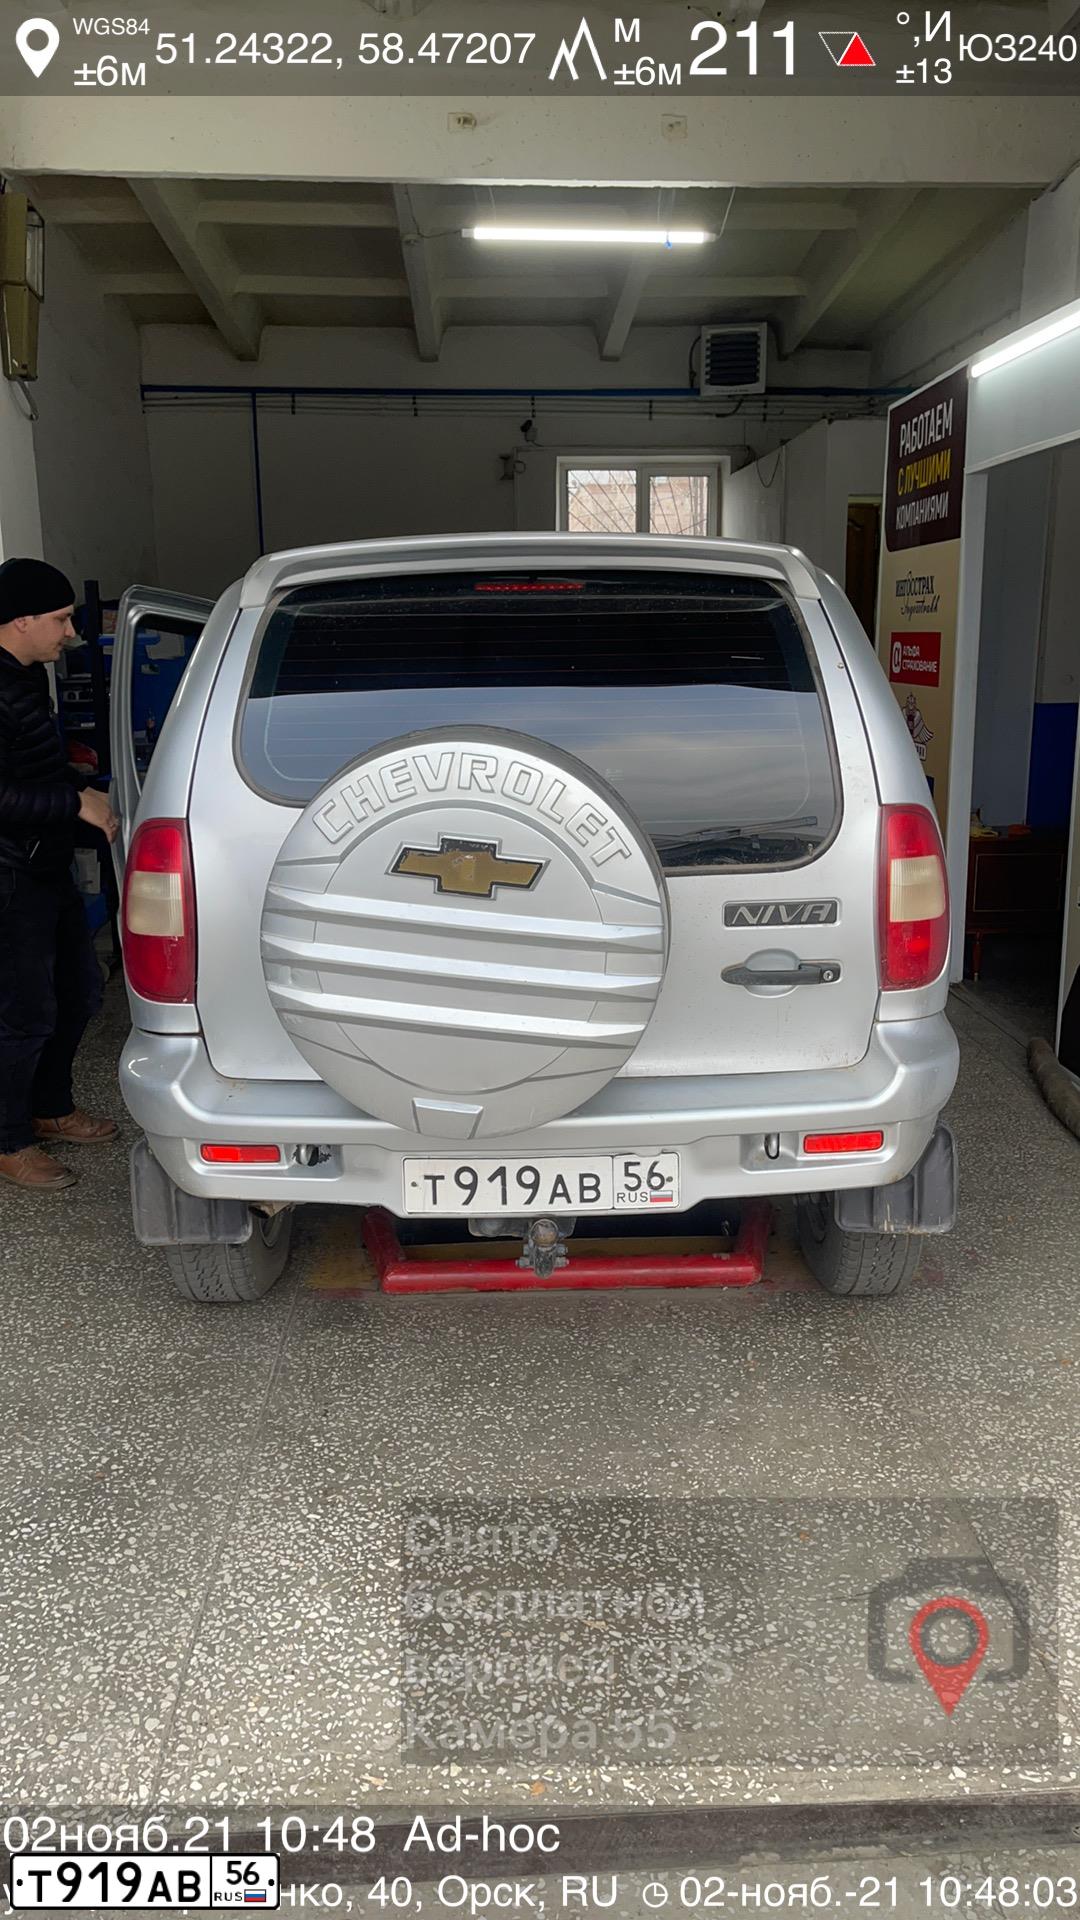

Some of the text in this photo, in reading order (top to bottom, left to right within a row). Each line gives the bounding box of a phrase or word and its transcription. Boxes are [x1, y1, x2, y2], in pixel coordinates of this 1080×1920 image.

[898, 398, 954, 458] РАБОТАЕМ
[903, 448, 951, 491] ЛУЧШИМИ
[895, 490, 950, 530] КОМПАНИЯМИ
[312, 751, 632, 867] CHEVROLET
[731, 903, 833, 924] NIVA
[623, 1161, 666, 1191] 56
[616, 1191, 649, 1203] RUS
